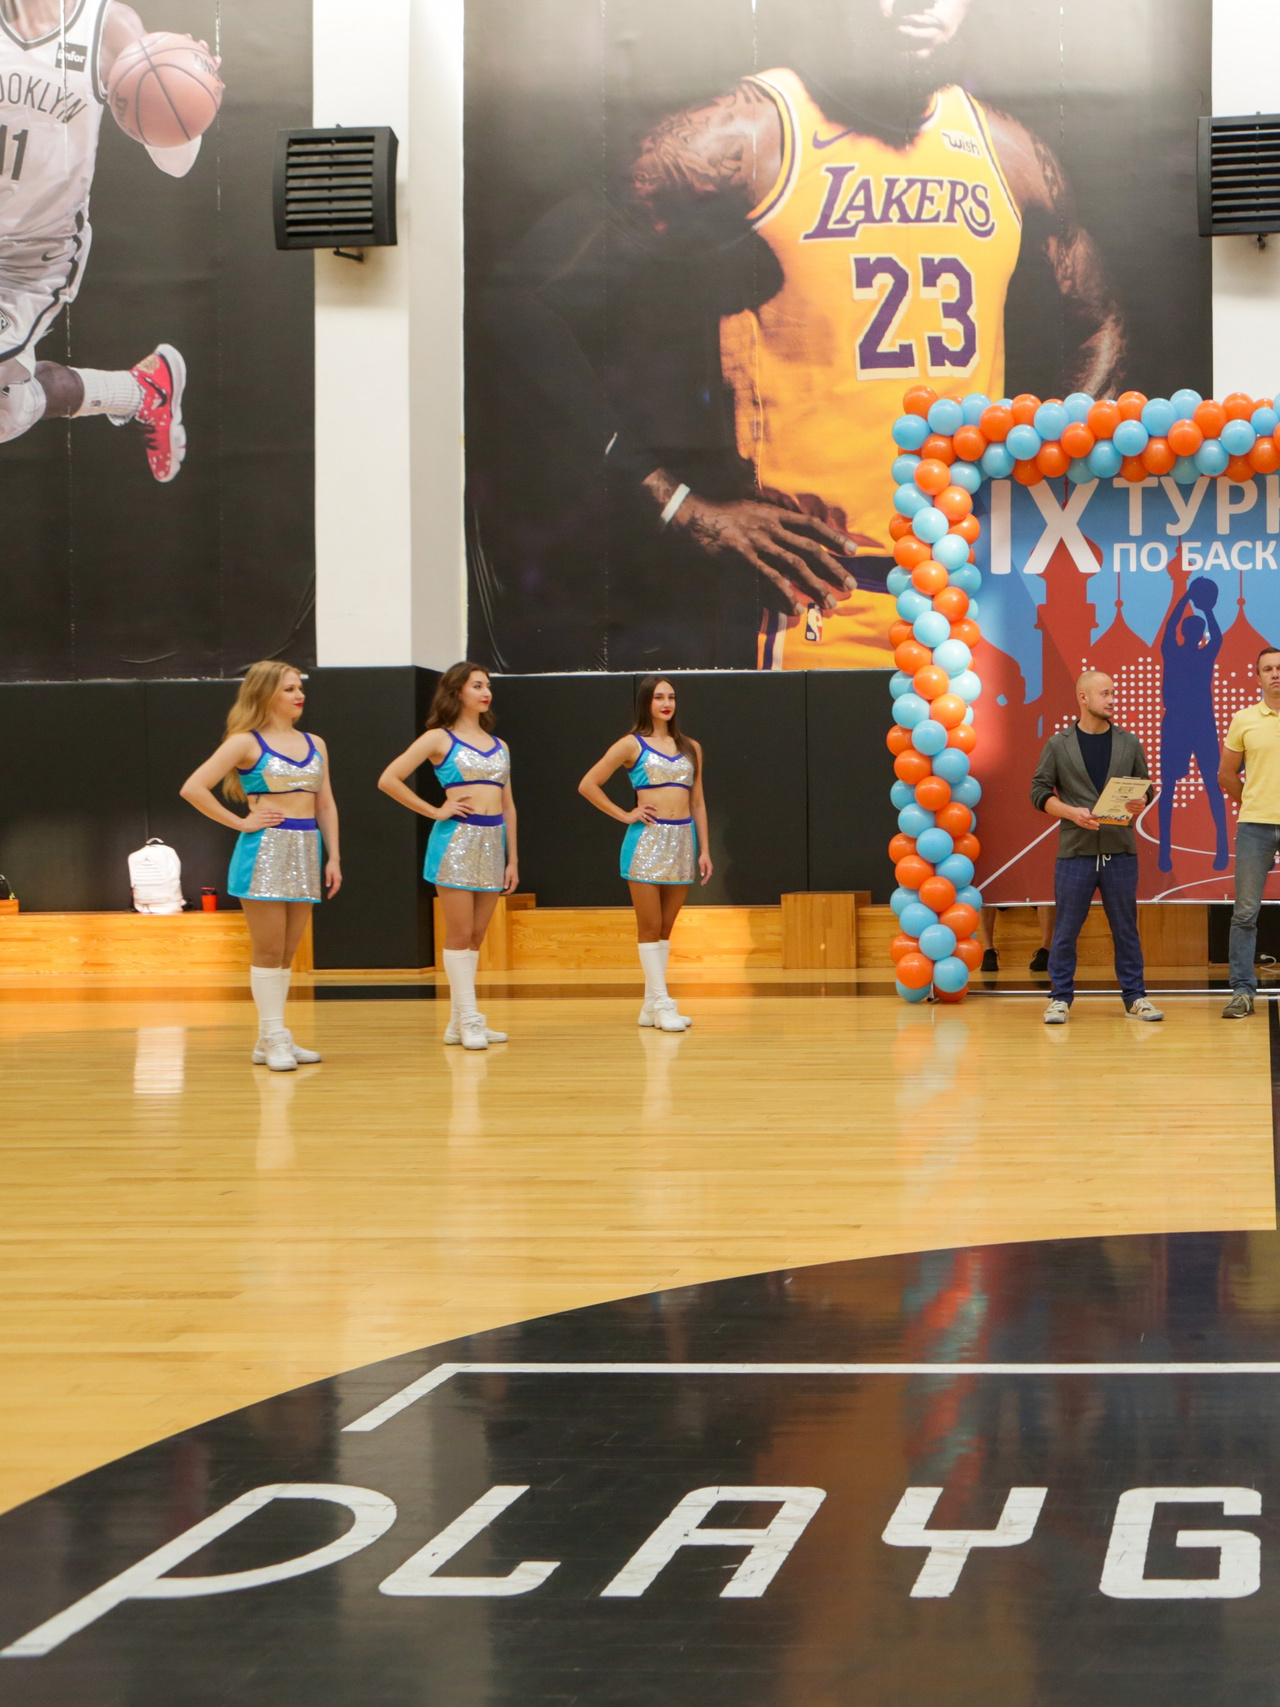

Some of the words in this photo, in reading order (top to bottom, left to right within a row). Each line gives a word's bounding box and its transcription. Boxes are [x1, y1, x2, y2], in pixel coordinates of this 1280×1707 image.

[942, 132, 980, 156] wish
[801, 164, 997, 241] LAKERS
[851, 255, 978, 376] 23
[990, 478, 1101, 575] IX
[1113, 542, 1168, 573] ПО
